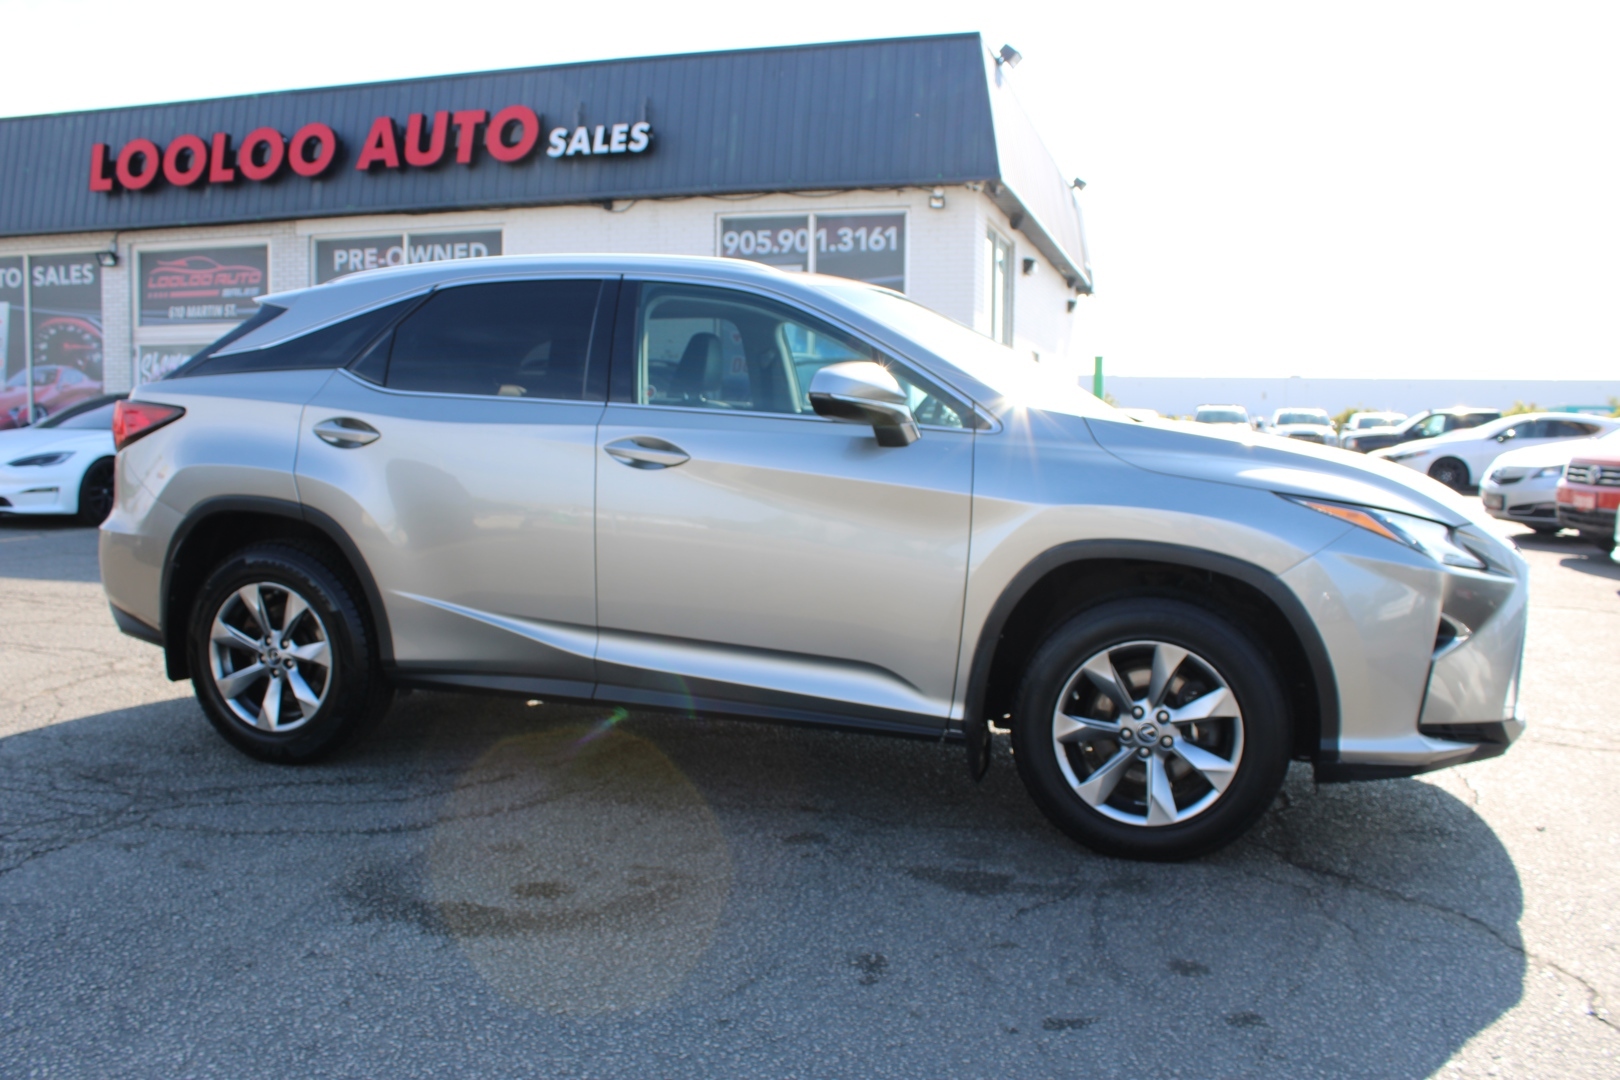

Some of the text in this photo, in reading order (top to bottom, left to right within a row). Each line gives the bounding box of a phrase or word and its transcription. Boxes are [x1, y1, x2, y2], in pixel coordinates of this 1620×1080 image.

[89, 105, 650, 192] LOOLOO AUTO SALES
[723, 226, 898, 256] 905.901.3161
[333, 241, 488, 272] PRE-OWNED
[32, 262, 95, 287] SALES
[147, 271, 262, 289] LOOLOO AUTO
[186, 304, 223, 318] MARTIN
